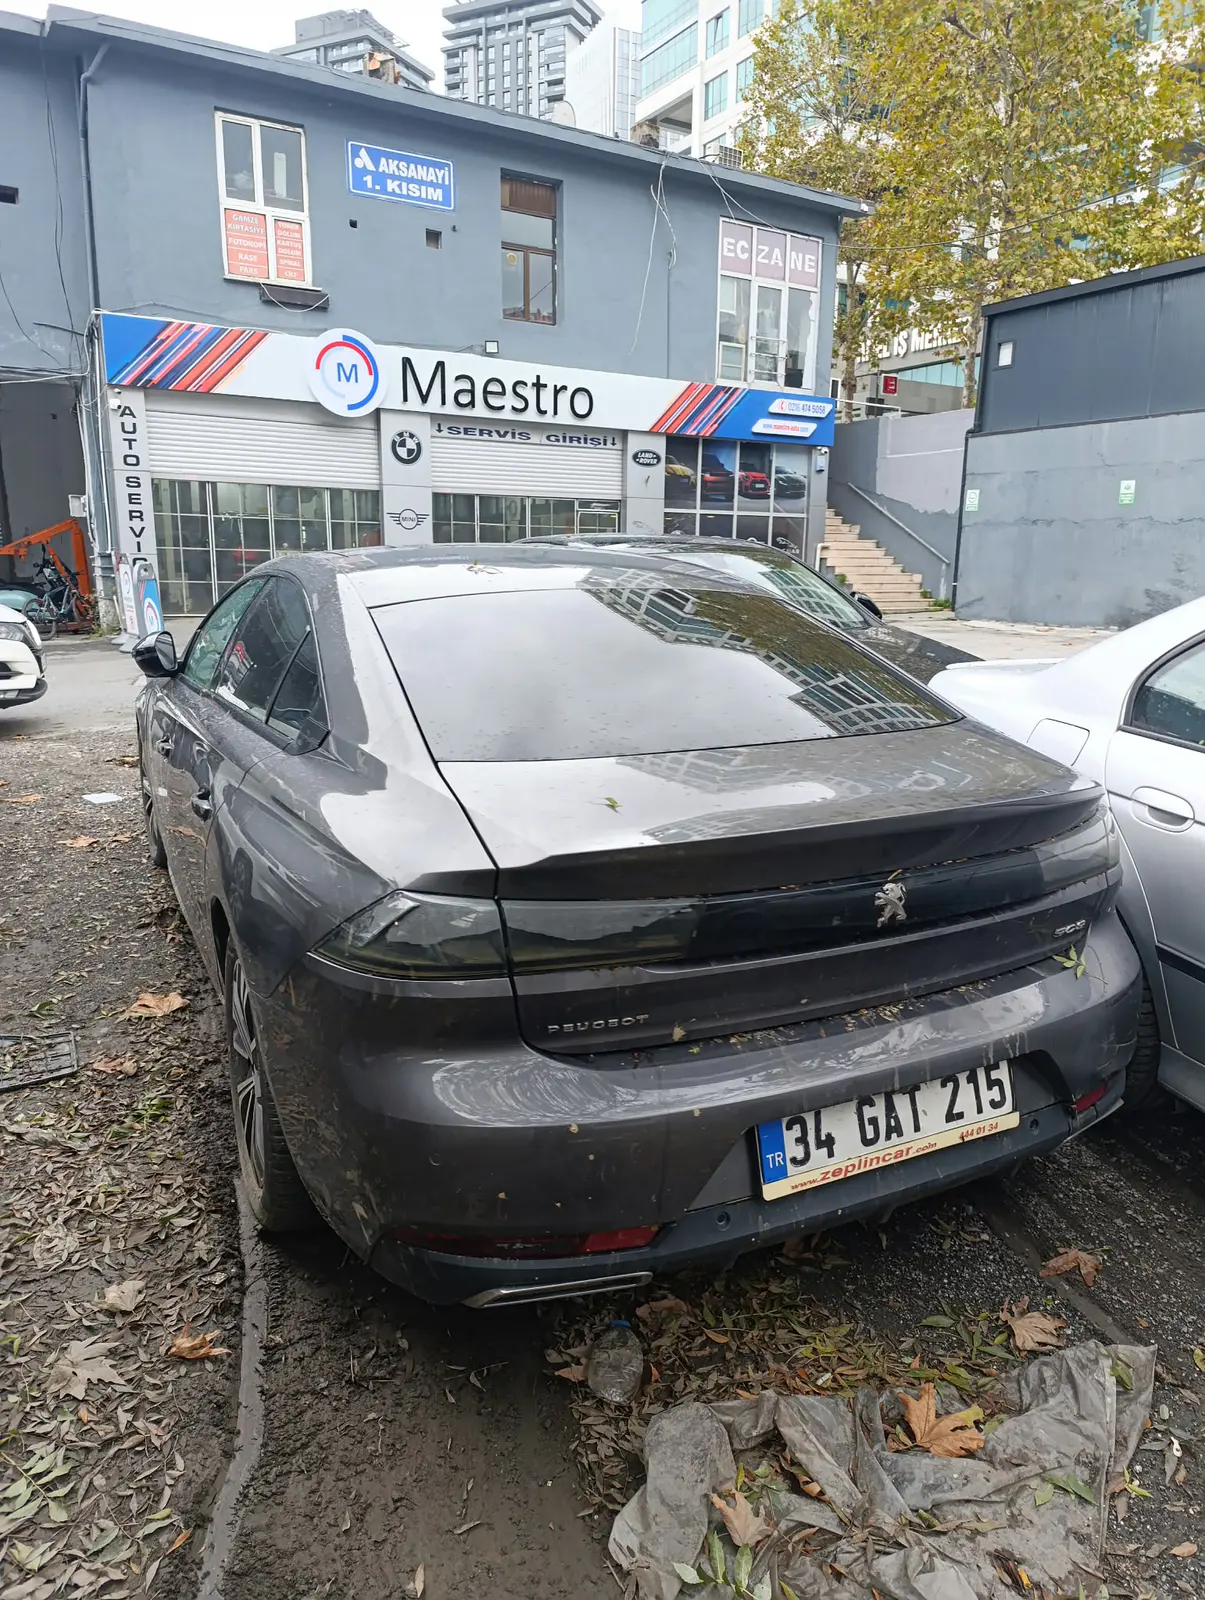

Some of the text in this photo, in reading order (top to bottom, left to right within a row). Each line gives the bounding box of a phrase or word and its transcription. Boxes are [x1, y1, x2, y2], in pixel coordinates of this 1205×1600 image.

[378, 157, 449, 185] AKSANAYİ
[363, 174, 443, 202] 1. KISIM
[232, 214, 258, 225] GAMZE
[336, 362, 359, 383] M
[401, 356, 594, 419] Maestro
[802, 404, 811, 412] 474
[118, 405, 140, 467] AUTO
[393, 431, 420, 444] BMW
[446, 425, 531, 441] SERVİS
[639, 457, 658, 465] ROVER
[547, 1014, 649, 1034] PEUGEOT
[765, 1062, 1008, 1169] TR 34 GAT 215
[790, 1121, 999, 1190] www.zeplincar.com 444 01 34
